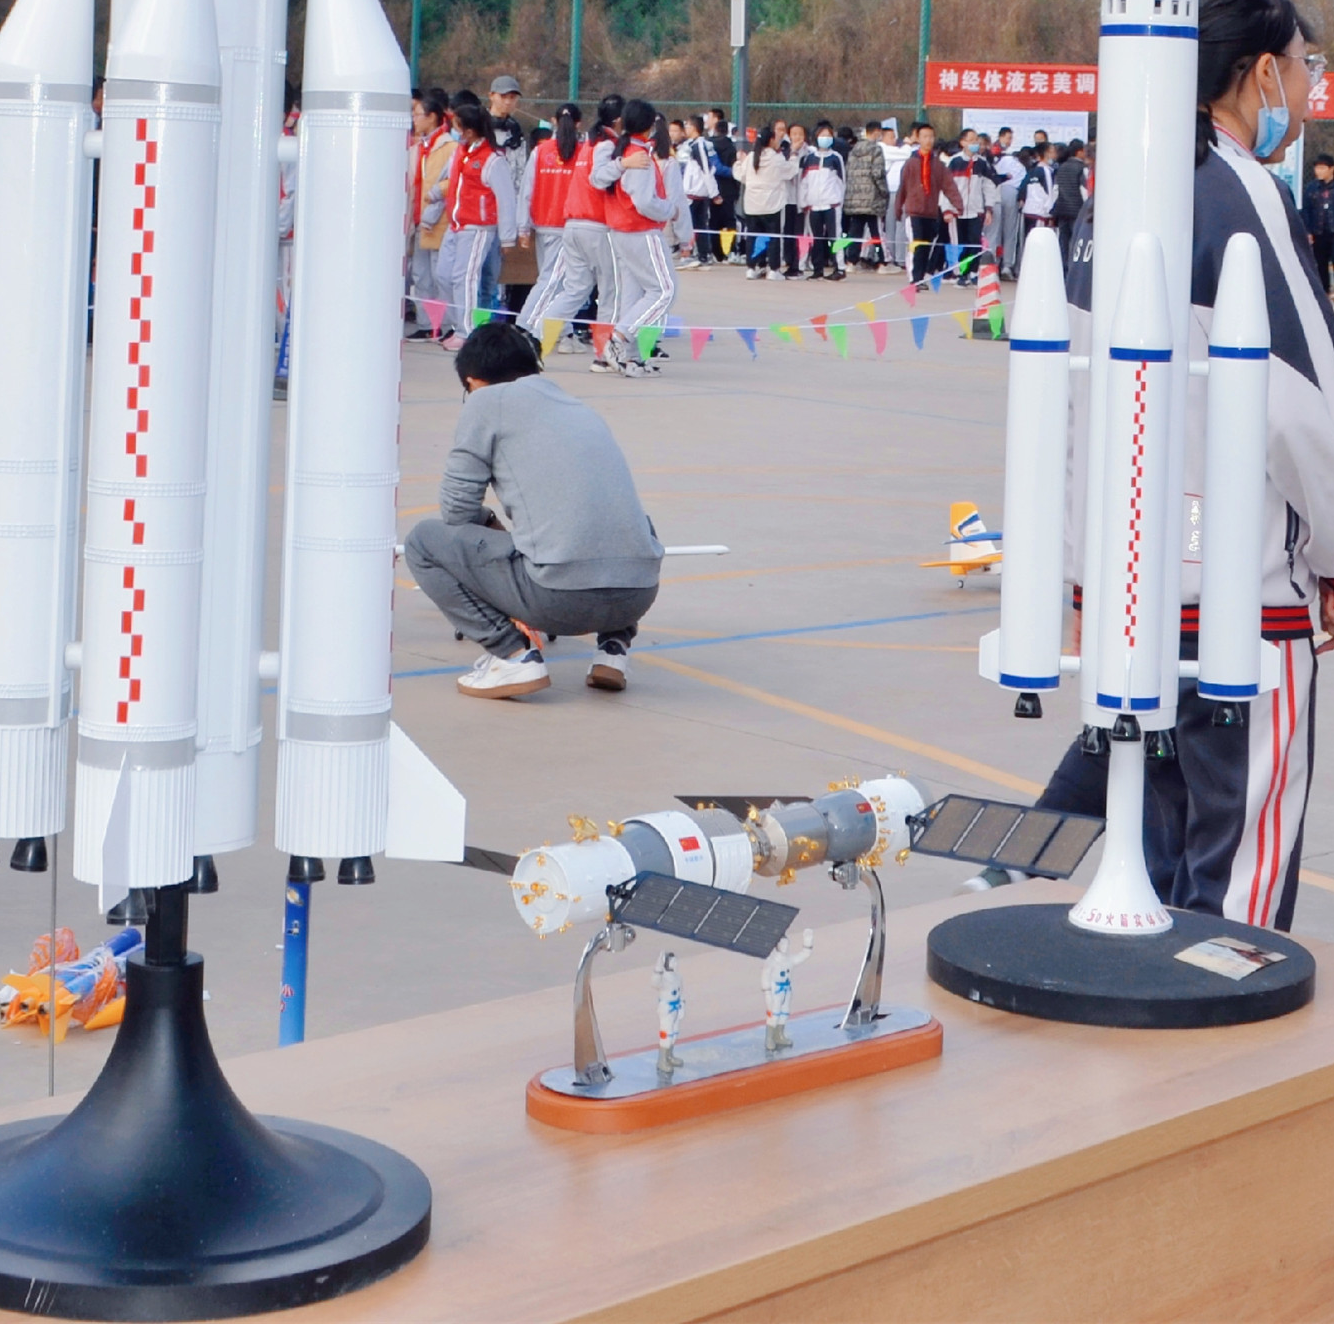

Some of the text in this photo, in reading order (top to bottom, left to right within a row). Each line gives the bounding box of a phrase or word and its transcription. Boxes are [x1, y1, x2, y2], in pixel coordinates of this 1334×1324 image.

[938, 67, 1097, 96] 神经体液完美调
